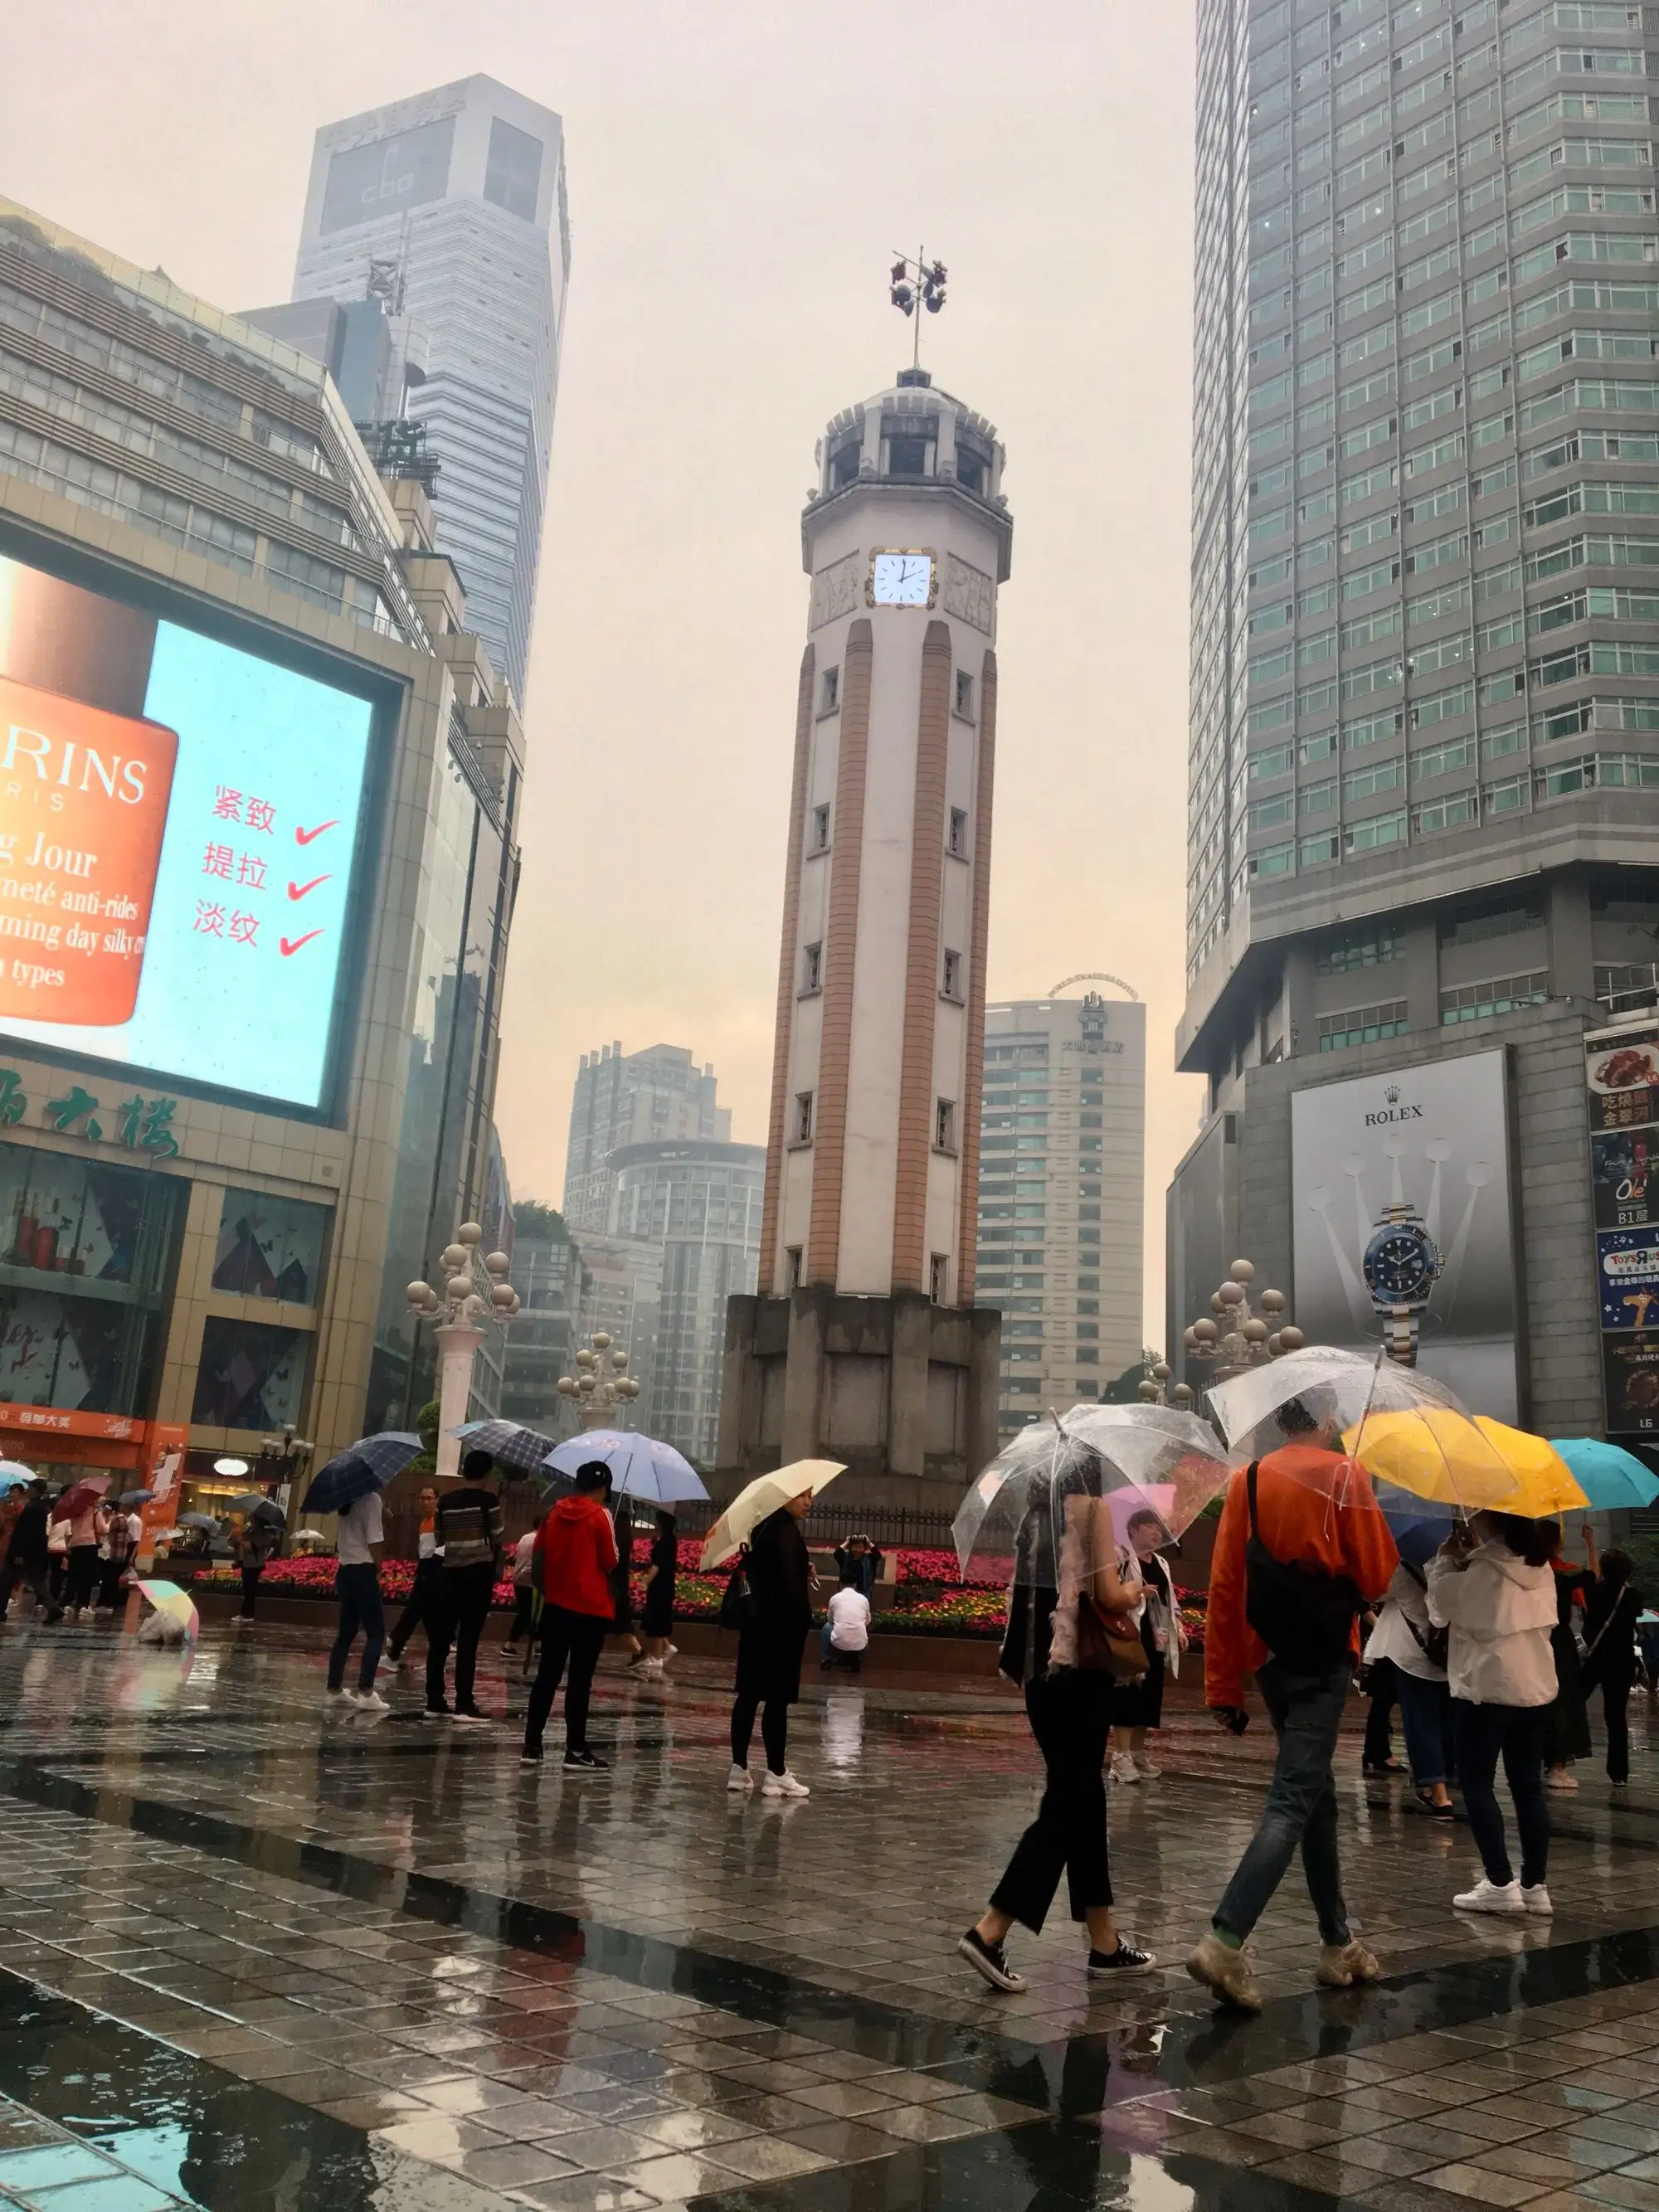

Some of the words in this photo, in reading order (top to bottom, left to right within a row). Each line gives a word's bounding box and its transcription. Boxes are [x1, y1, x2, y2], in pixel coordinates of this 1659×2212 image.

[1, 724, 148, 804] RINS
[6, 780, 64, 812] RIS
[212, 785, 277, 835] 紧致
[25, 831, 98, 878] Jour
[202, 841, 268, 891] 提拉
[61, 891, 139, 921] anti-rides
[193, 898, 260, 947] 淡纹
[66, 921, 100, 957] day
[12, 958, 66, 989] types
[1365, 1104, 1423, 1126] ROLEX
[1618, 1210, 1648, 1224] B1层
